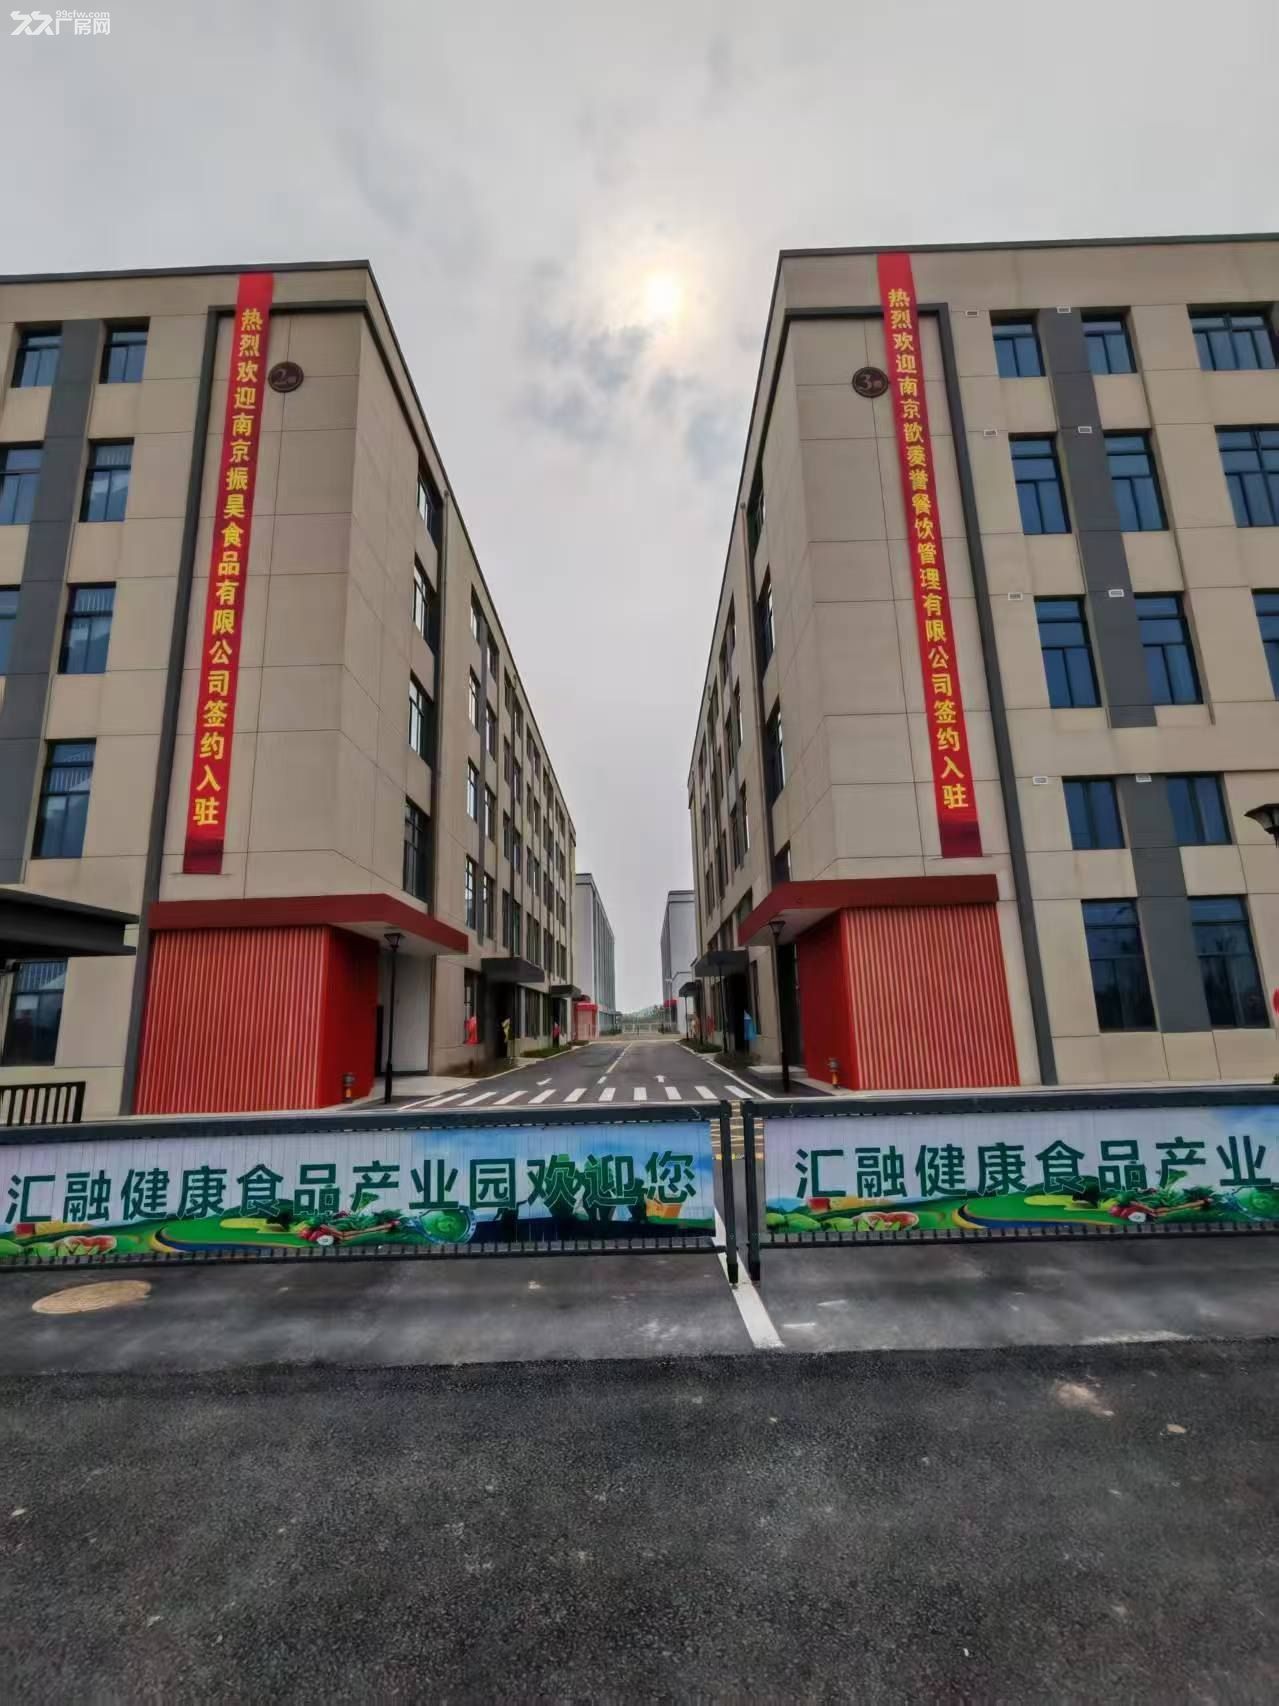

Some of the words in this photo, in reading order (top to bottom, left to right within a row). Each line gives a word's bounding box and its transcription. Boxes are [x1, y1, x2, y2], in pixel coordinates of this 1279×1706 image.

[193, 308, 264, 826] 热烈欢迎南京振昊食品有限公司签约入驻
[4, 1150, 696, 1225] 汇融健康食品产业园欢迎您
[794, 1135, 1272, 1200] 汇融健康食品产业
